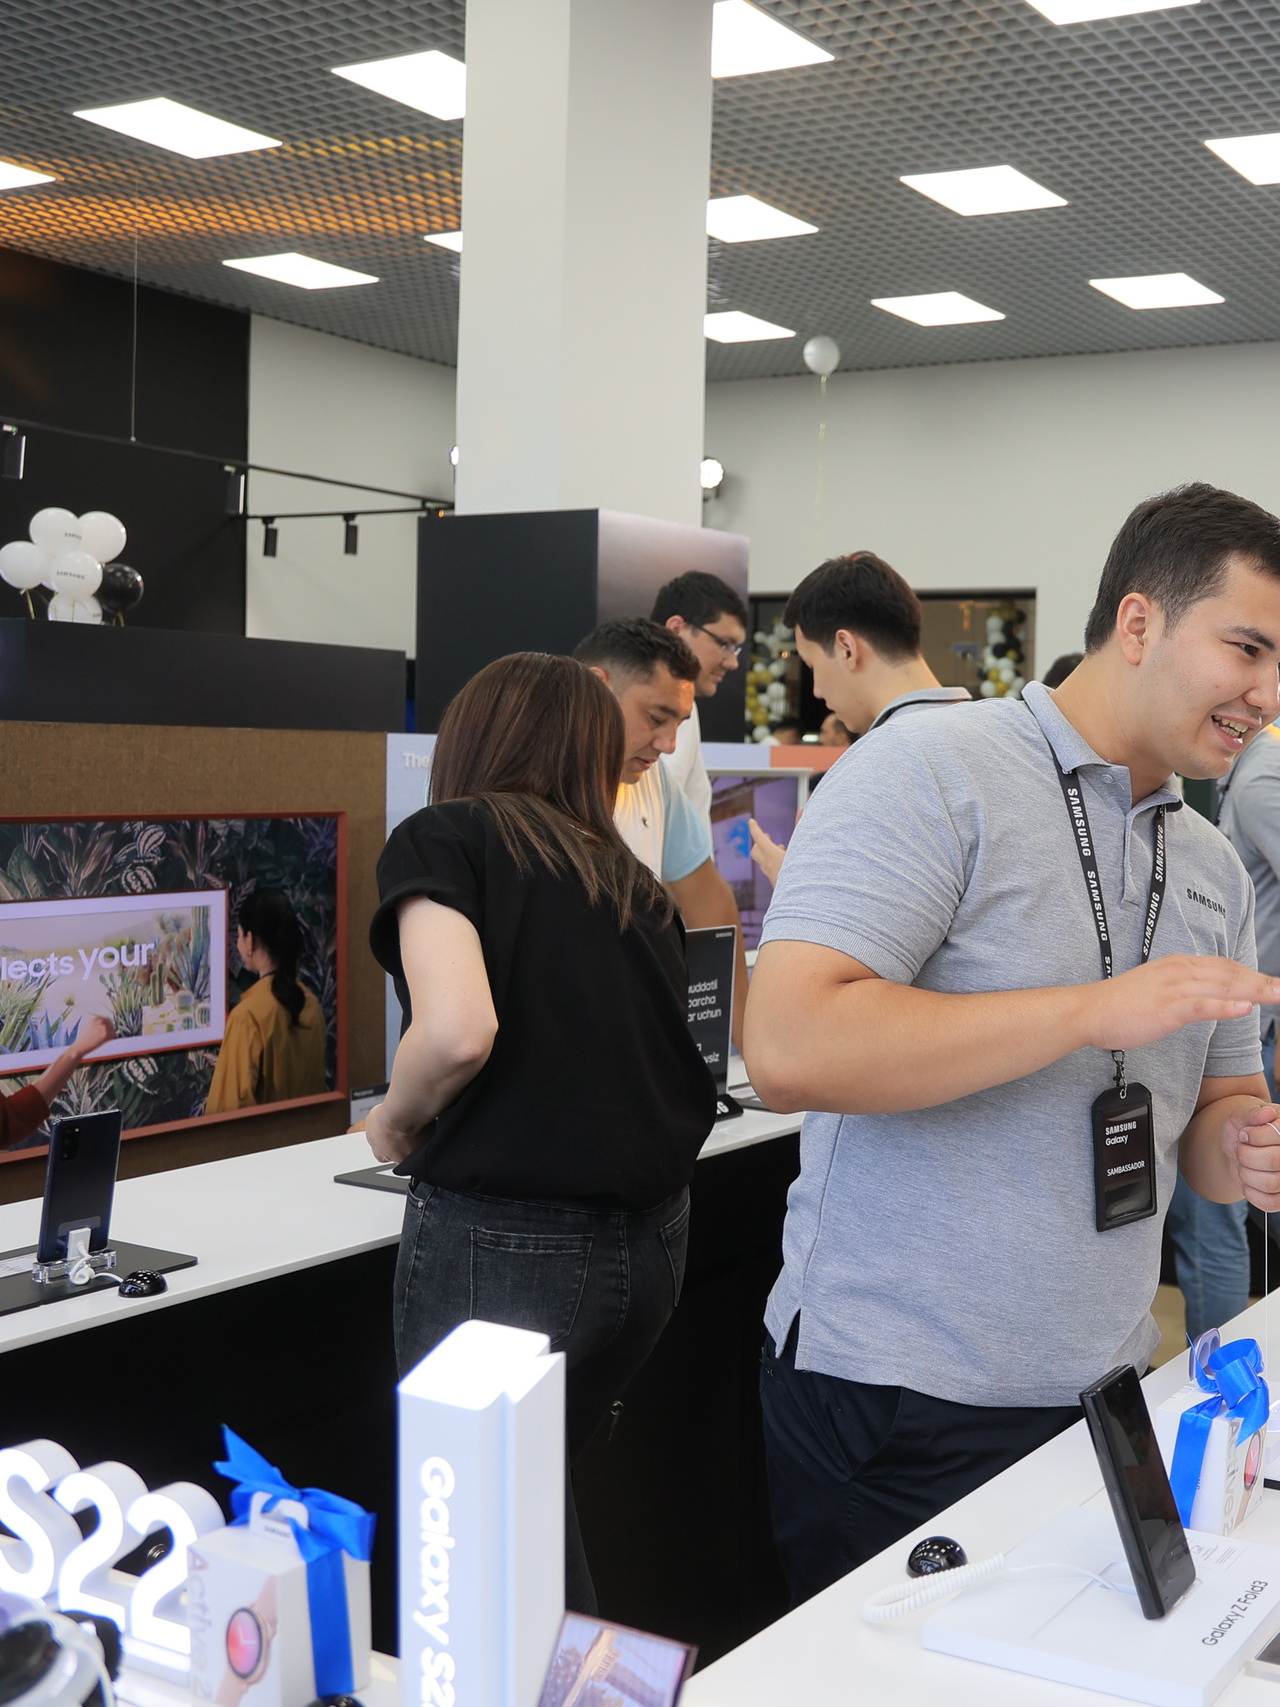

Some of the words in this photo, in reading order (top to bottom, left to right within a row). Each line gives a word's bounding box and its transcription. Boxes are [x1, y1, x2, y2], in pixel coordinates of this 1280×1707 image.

[1067, 788, 1092, 857] SAMSUNG
[1155, 824, 1165, 883] SAMSUNG
[1087, 870, 1107, 942] SAMSUNG
[1142, 891, 1161, 956] SAMSUNG
[0, 952, 75, 981] lects
[78, 942, 155, 981] your
[688, 979, 718, 994] uddatli
[1105, 1120, 1137, 1136] SAMSUNG
[1105, 1134, 1129, 1146] Galaxy
[1106, 1160, 1146, 1177] SAMBASSADOR
[0, 1446, 205, 1656] S22
[412, 1455, 456, 1646] Galaxy
[1231, 1604, 1249, 1612] Z
[1236, 1580, 1269, 1605] Fold3
[1201, 1610, 1246, 1646] Galaxy
